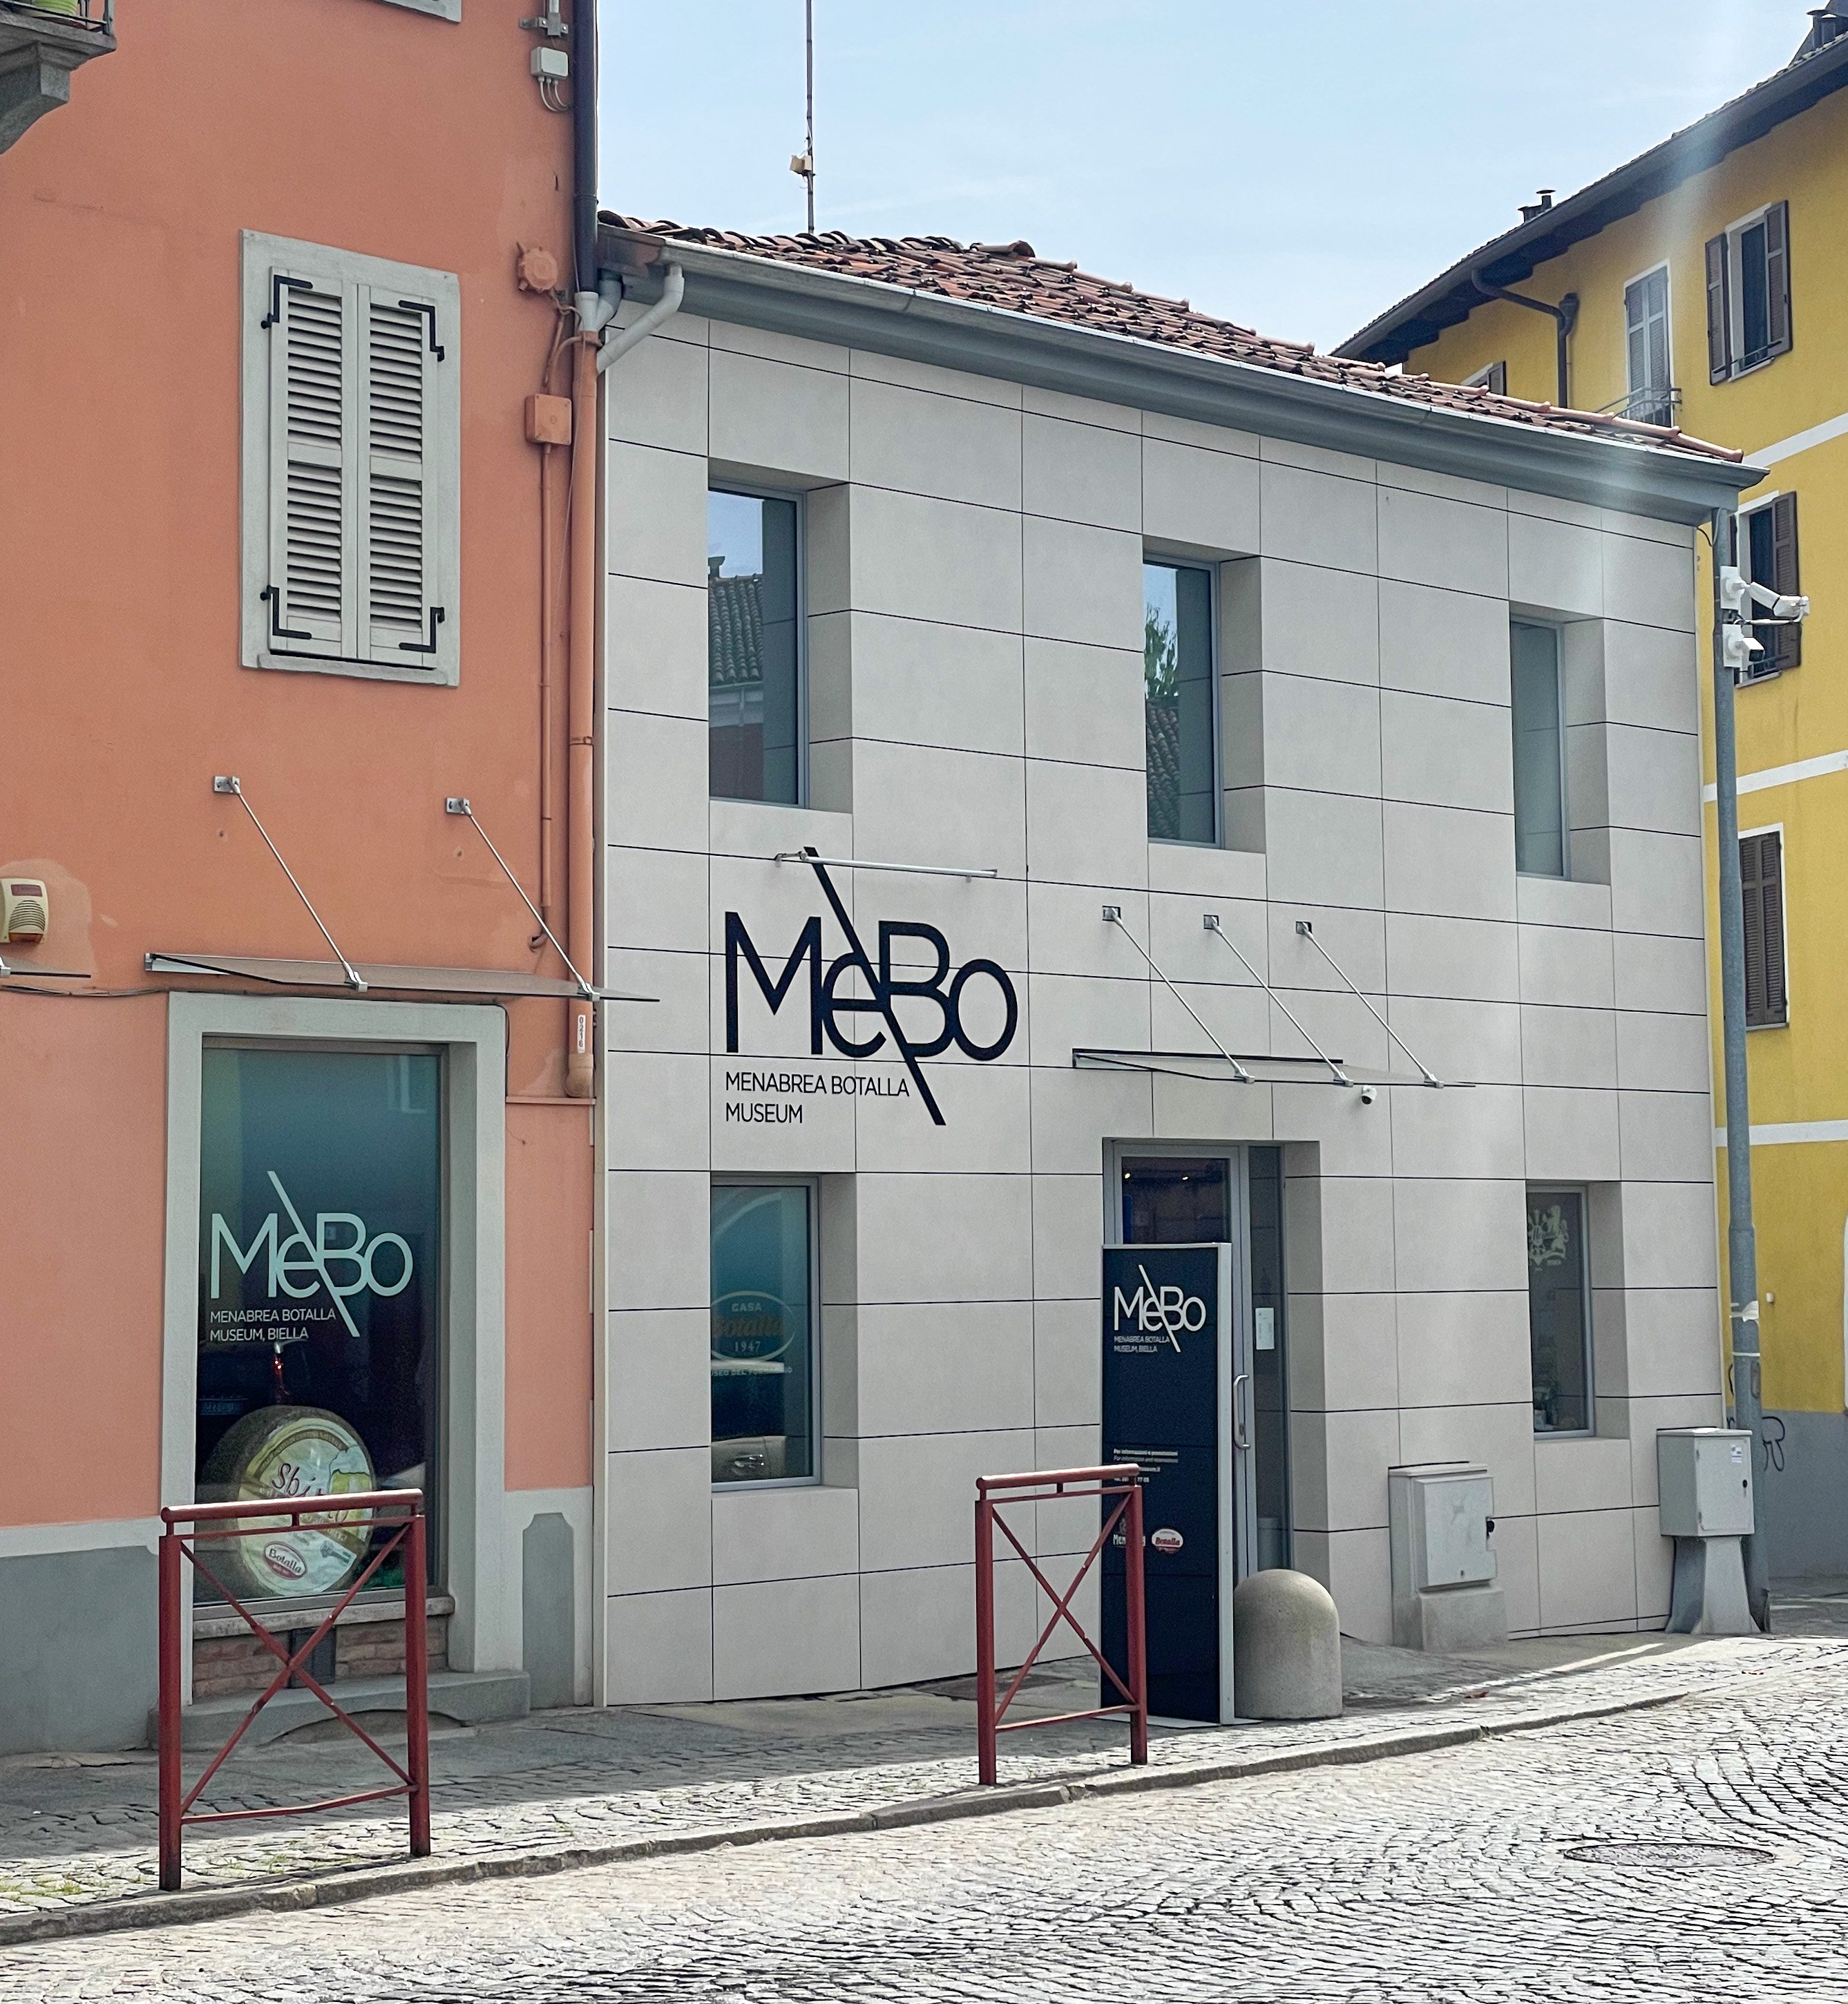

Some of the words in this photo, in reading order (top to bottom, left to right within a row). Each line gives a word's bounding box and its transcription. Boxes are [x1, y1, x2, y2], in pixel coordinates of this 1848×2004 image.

[725, 1071, 827, 1094] MENABREA
[831, 1075, 910, 1097] BOTALLA
[725, 1103, 803, 1123] MUSEUM
[732, 1303, 762, 1312] CASA
[210, 1309, 279, 1323] MENABREA
[282, 1308, 336, 1321] BOTALLA
[210, 1328, 265, 1342] MUSEUM,
[267, 1327, 309, 1340] BIELLA
[734, 1341, 761, 1352] 1947
[268, 1548, 302, 1573] Botalla
